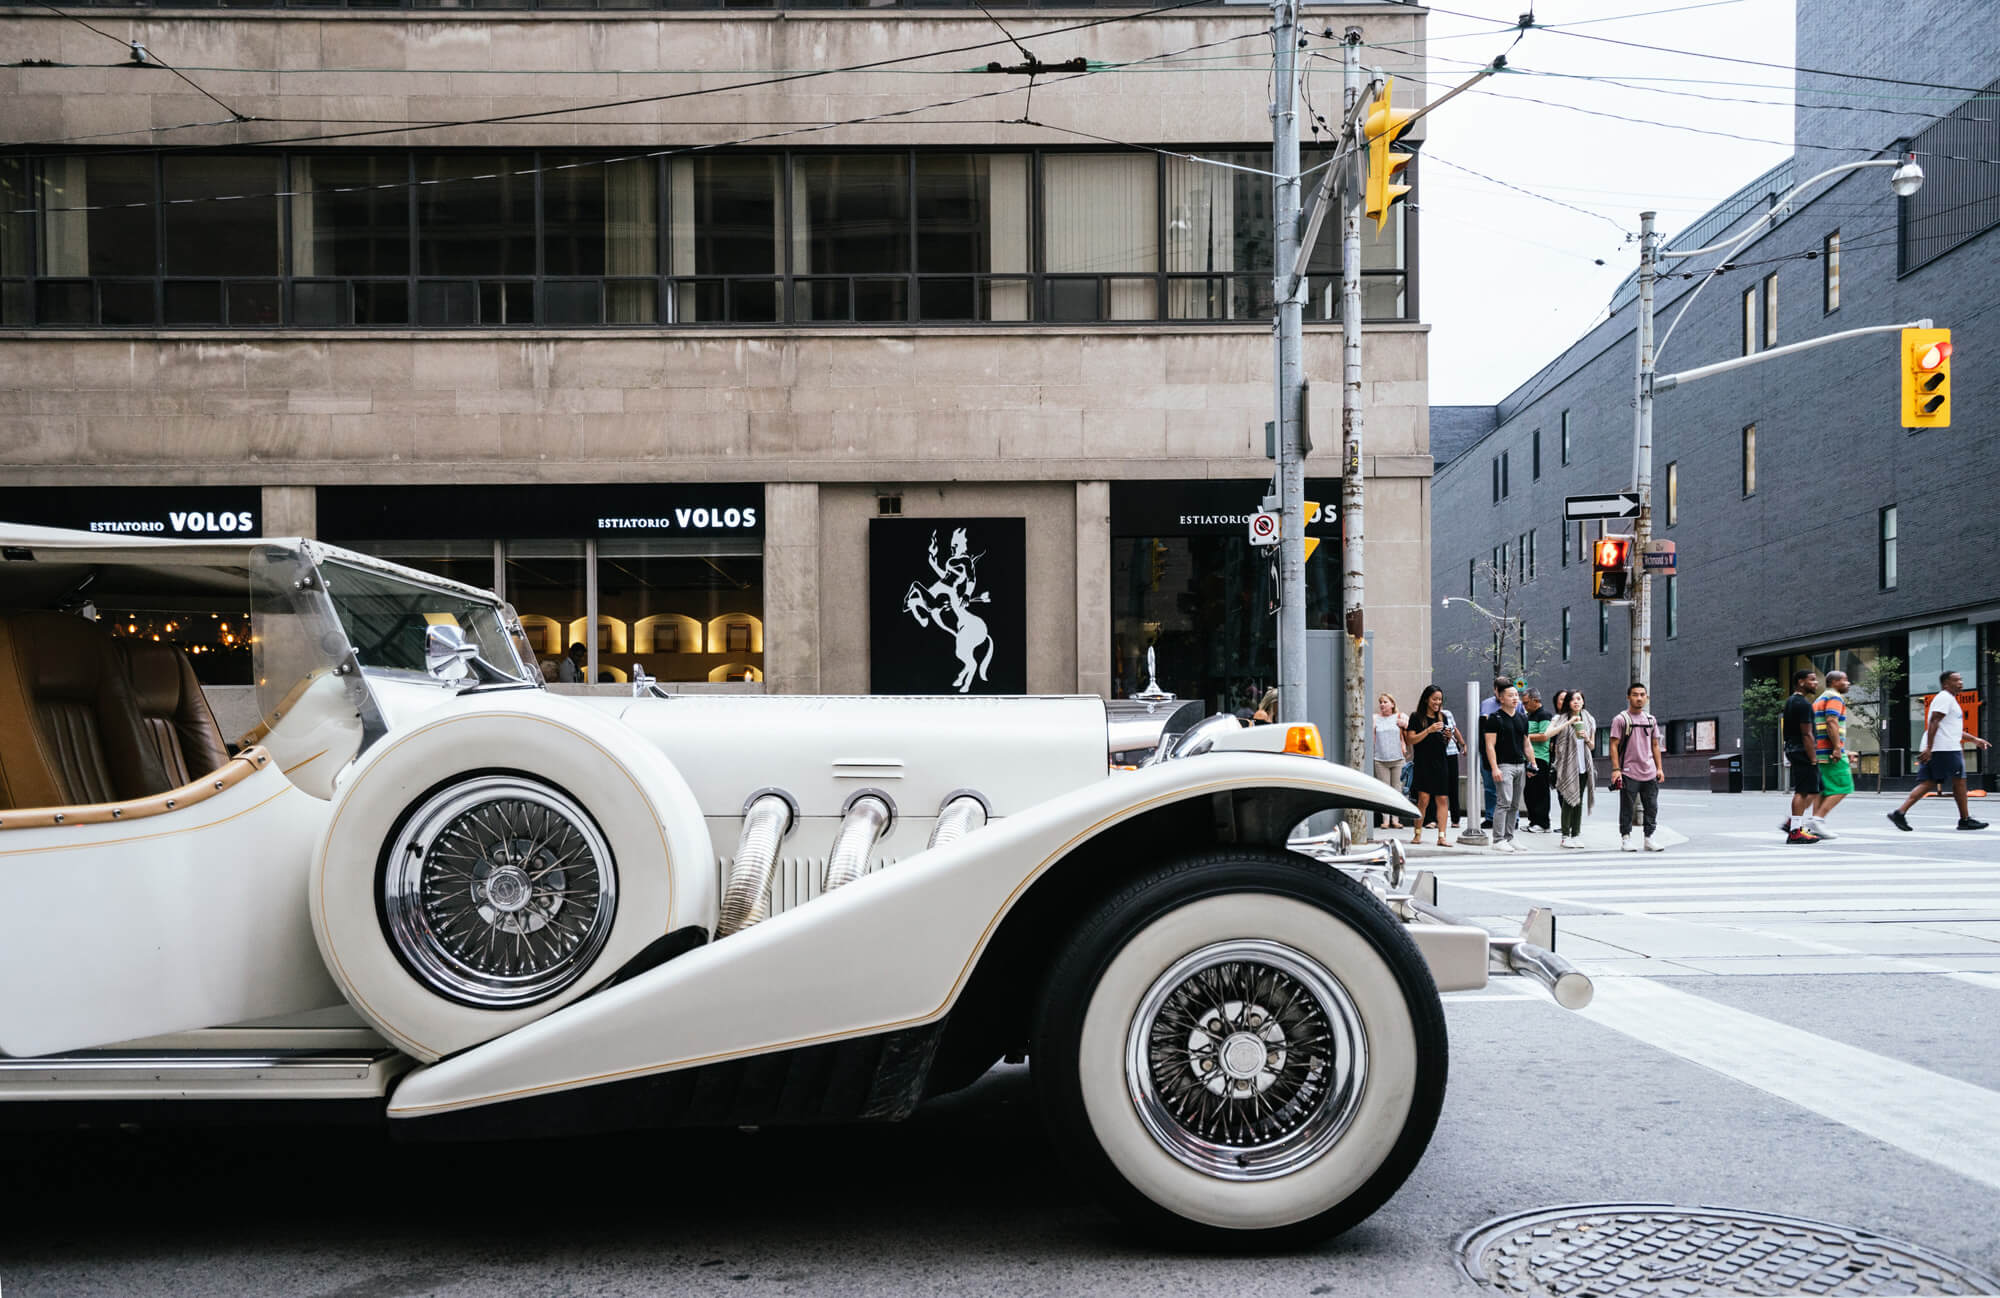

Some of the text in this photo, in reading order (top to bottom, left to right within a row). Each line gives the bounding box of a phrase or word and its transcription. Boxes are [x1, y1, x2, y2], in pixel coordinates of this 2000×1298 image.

[1352, 457, 1358, 467] 2
[90, 512, 253, 532] ESTIATORIO VOLOS
[598, 508, 756, 528] ESTIATORIO VOLOS
[1180, 515, 1250, 525] ESTIATORIO
